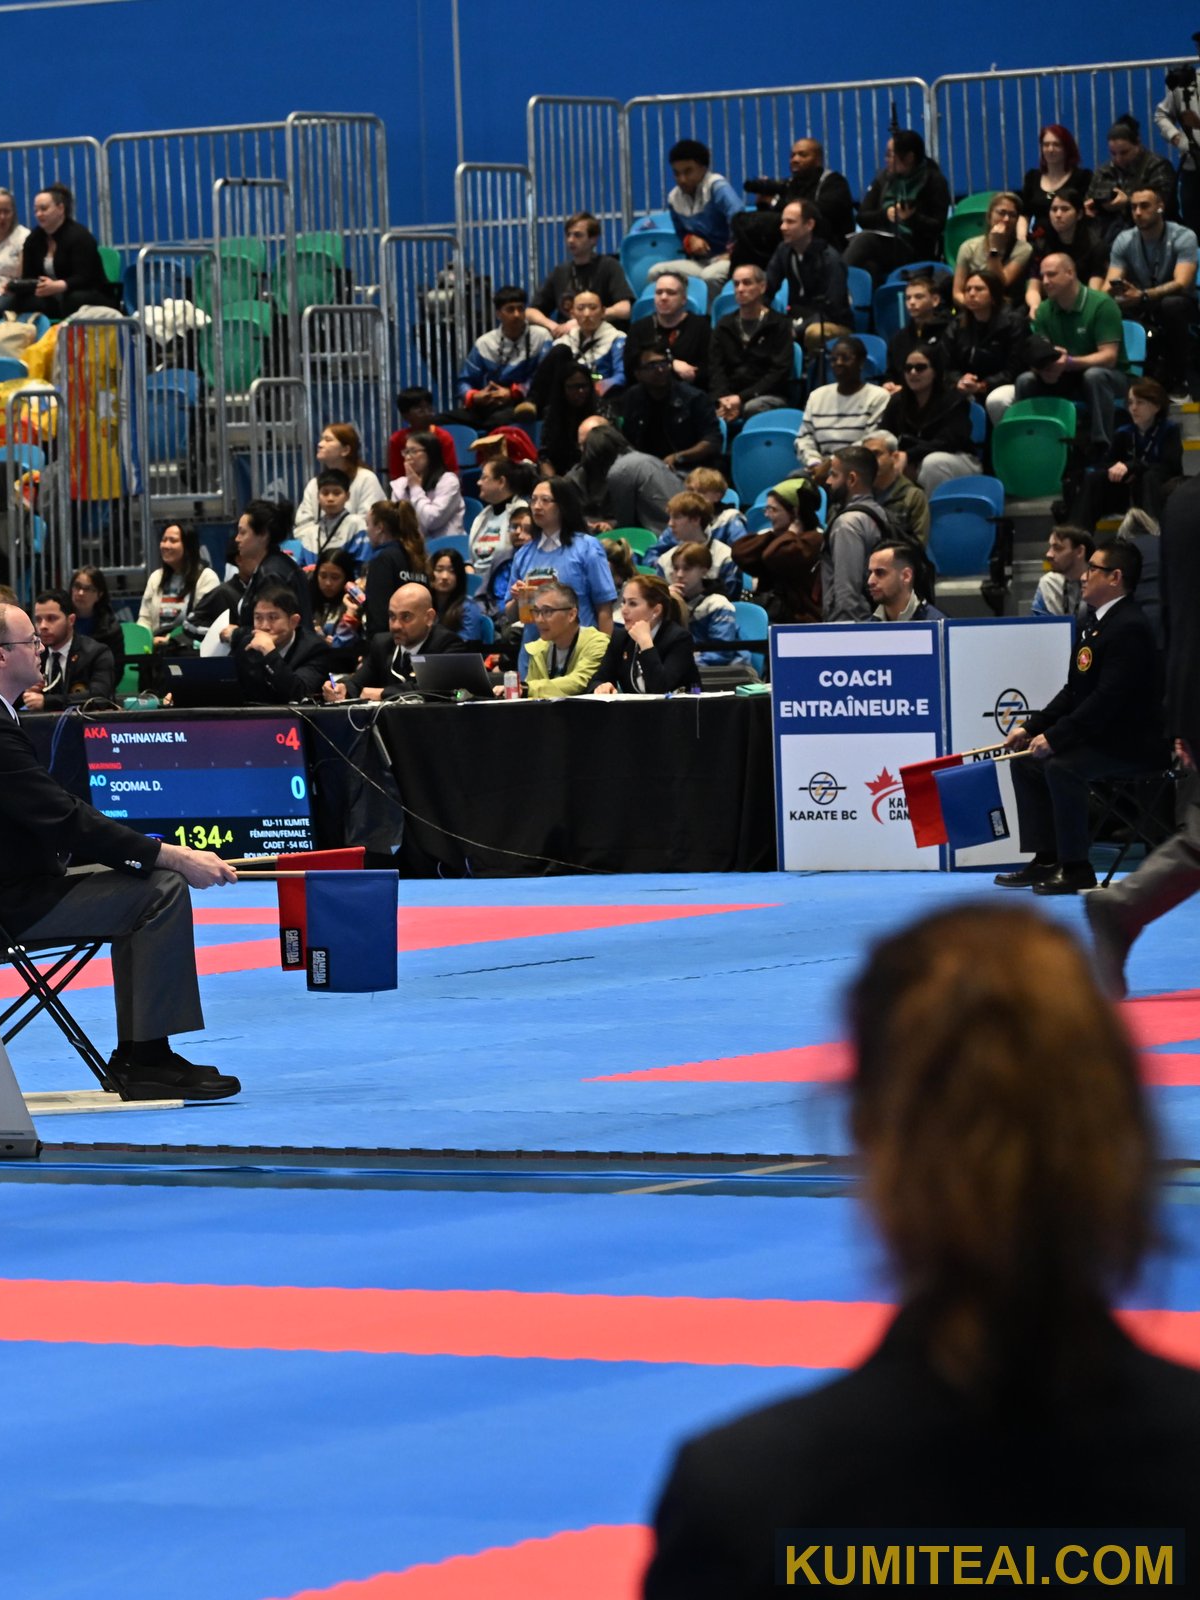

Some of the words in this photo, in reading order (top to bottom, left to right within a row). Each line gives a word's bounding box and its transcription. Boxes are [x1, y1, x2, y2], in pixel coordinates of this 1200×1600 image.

[819, 669, 892, 687] COACH
[780, 695, 929, 718] ENTRAÎNEUR·E
[84, 727, 108, 739] AKA
[111, 732, 173, 744] RATHNAYAKE
[174, 731, 187, 743] M.
[89, 774, 106, 787] AO
[110, 781, 151, 792] SOOMAL
[153, 780, 163, 791] D.
[290, 775, 306, 800] 0
[789, 810, 838, 821] KARATE
[842, 810, 857, 821] BC
[262, 819, 283, 827] KU-11
[284, 818, 309, 826] KUMITE
[174, 825, 233, 849] 1:34.4
[263, 841, 285, 849] CADET
